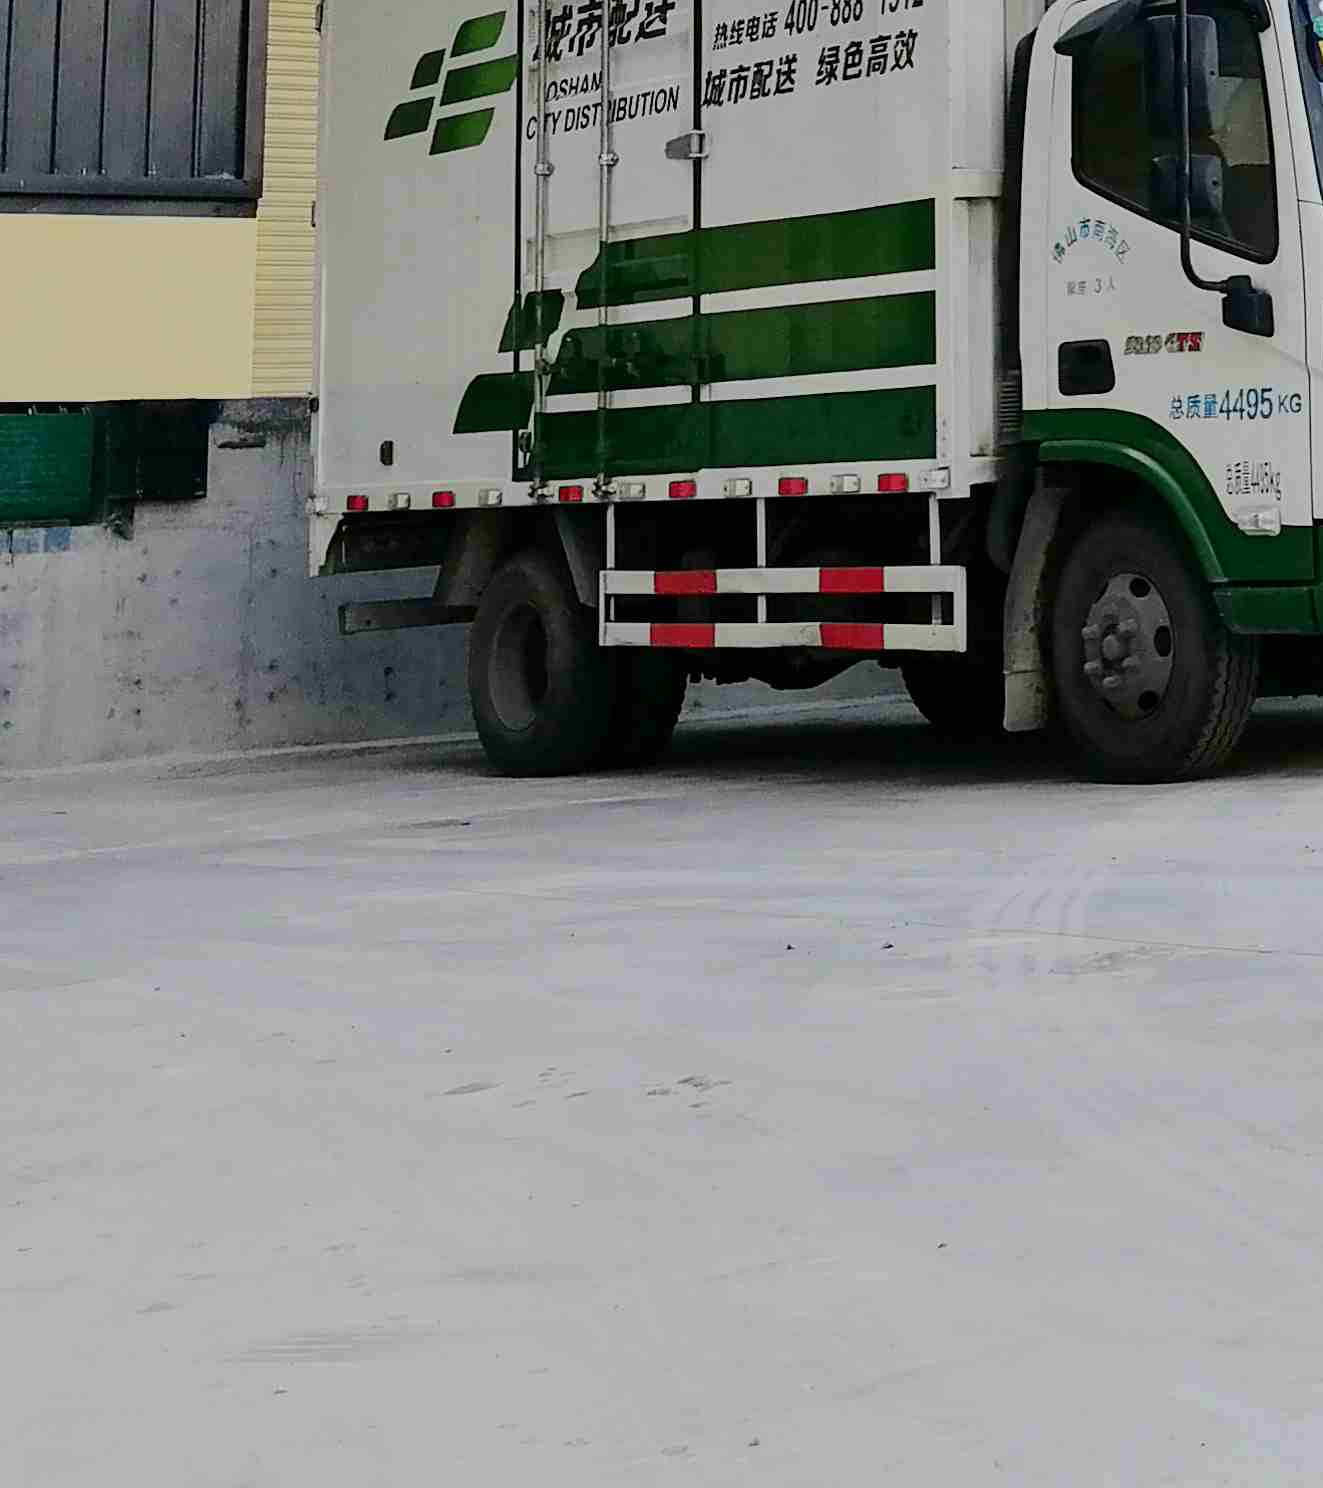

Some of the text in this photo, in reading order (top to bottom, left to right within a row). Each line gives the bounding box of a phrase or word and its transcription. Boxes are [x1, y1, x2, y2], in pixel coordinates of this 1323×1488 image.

[713, 12, 778, 50] 热线电话
[702, 29, 918, 107] 城市配送 绿色高效
[544, 70, 602, 103] OSHAN
[526, 110, 562, 140] CTY
